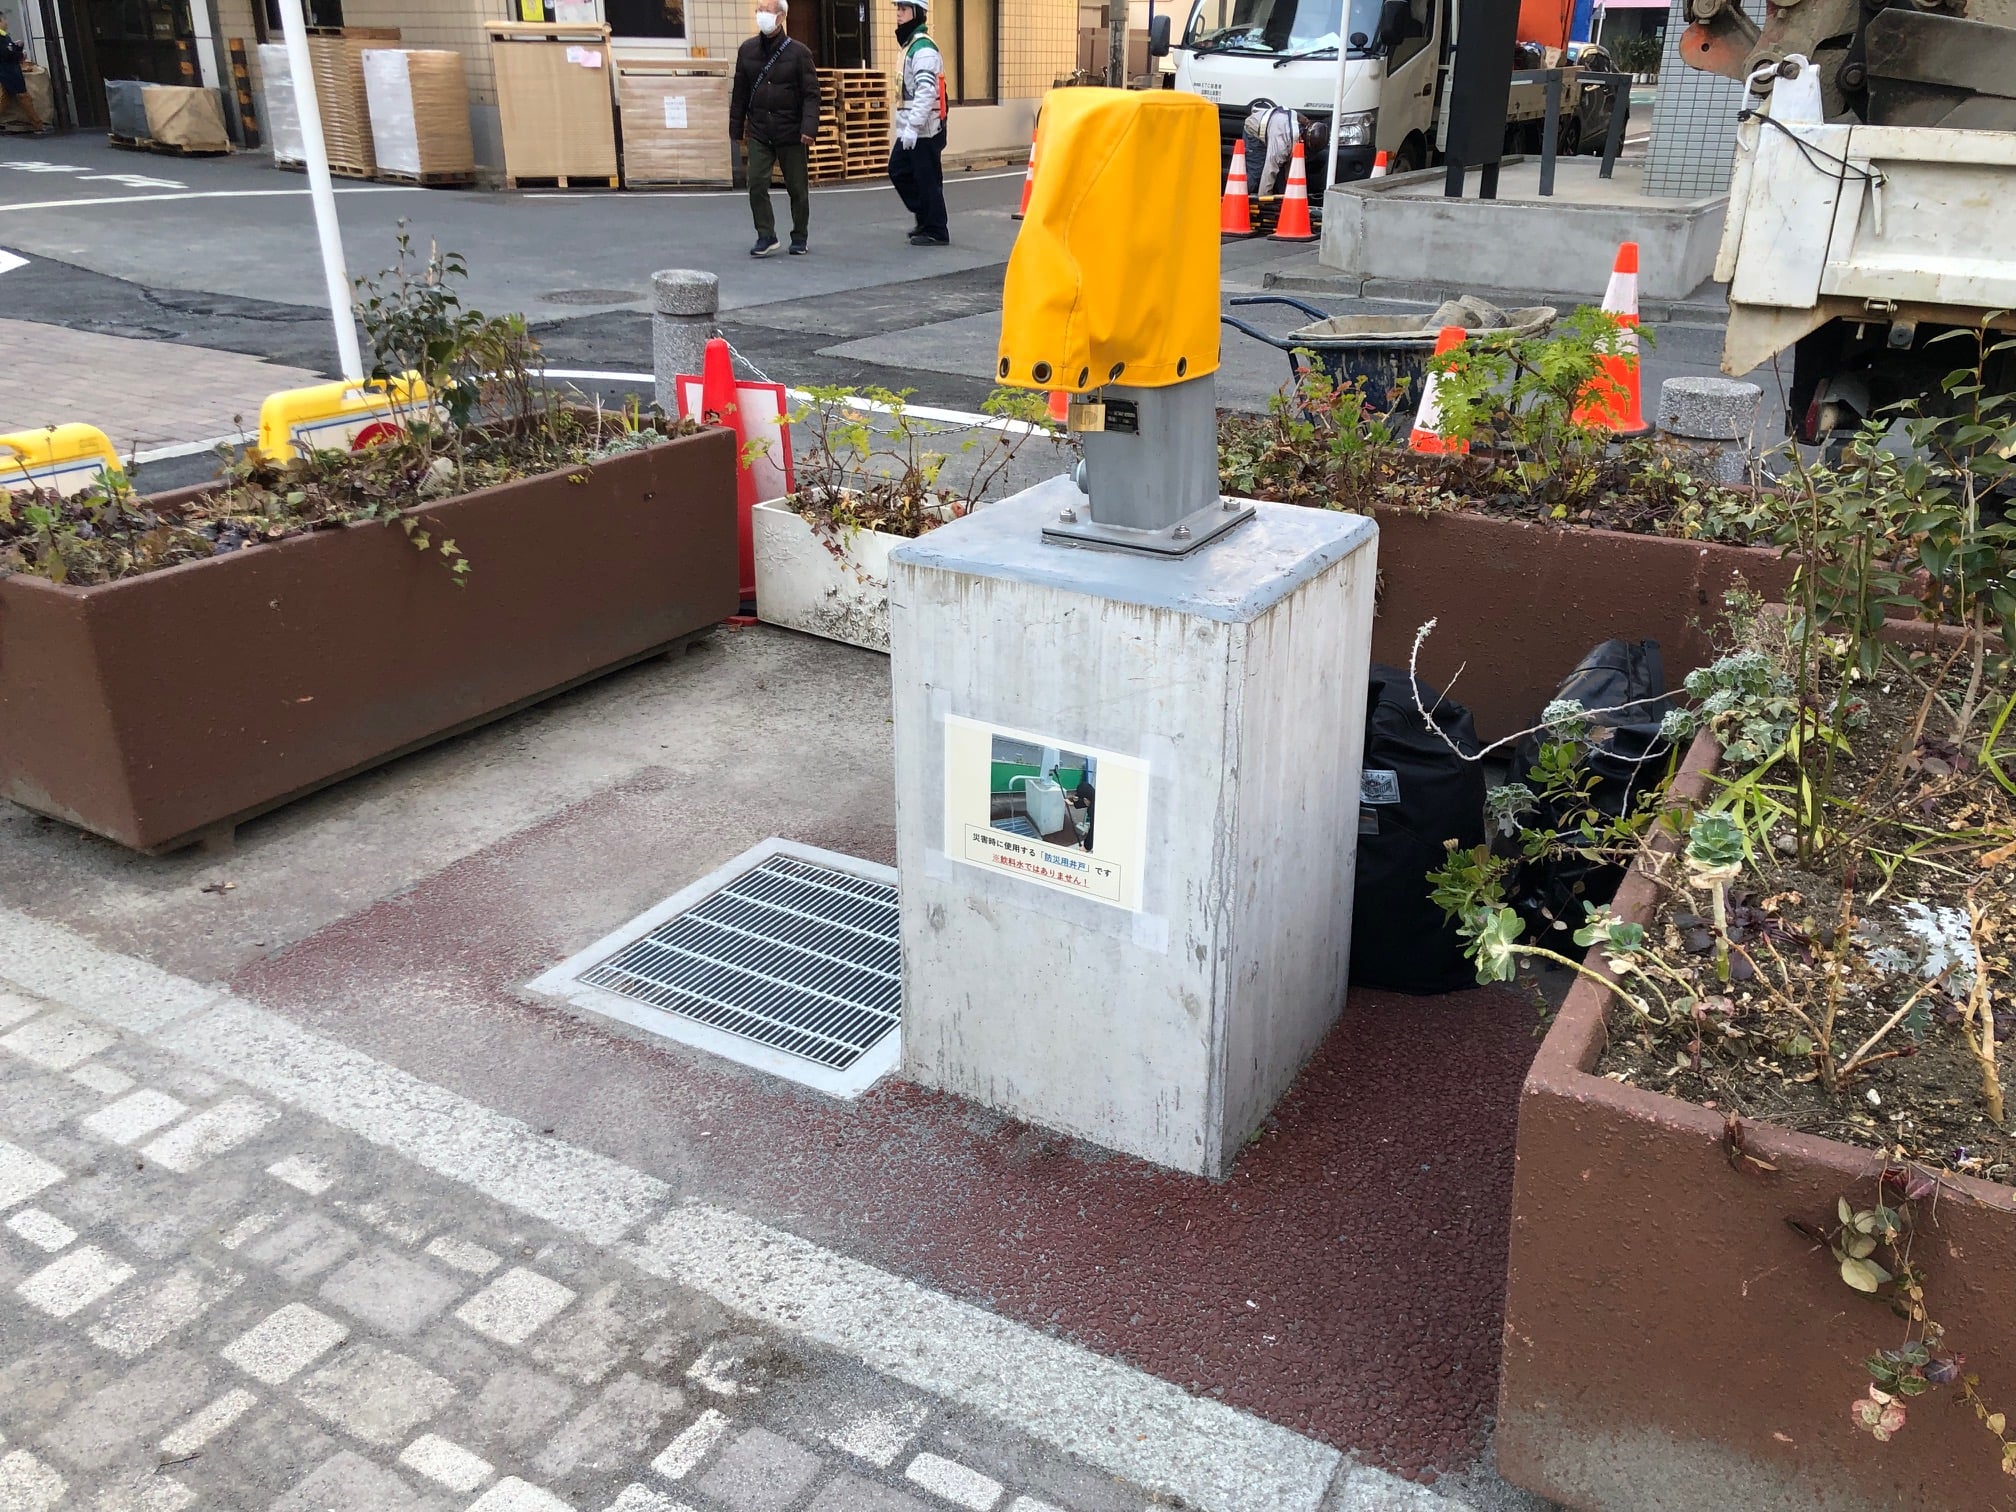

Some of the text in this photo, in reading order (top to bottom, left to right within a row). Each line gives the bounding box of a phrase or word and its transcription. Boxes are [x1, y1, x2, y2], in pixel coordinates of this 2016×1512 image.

[972, 832, 1112, 877] 災害時に使用する「防災用井戸」です
